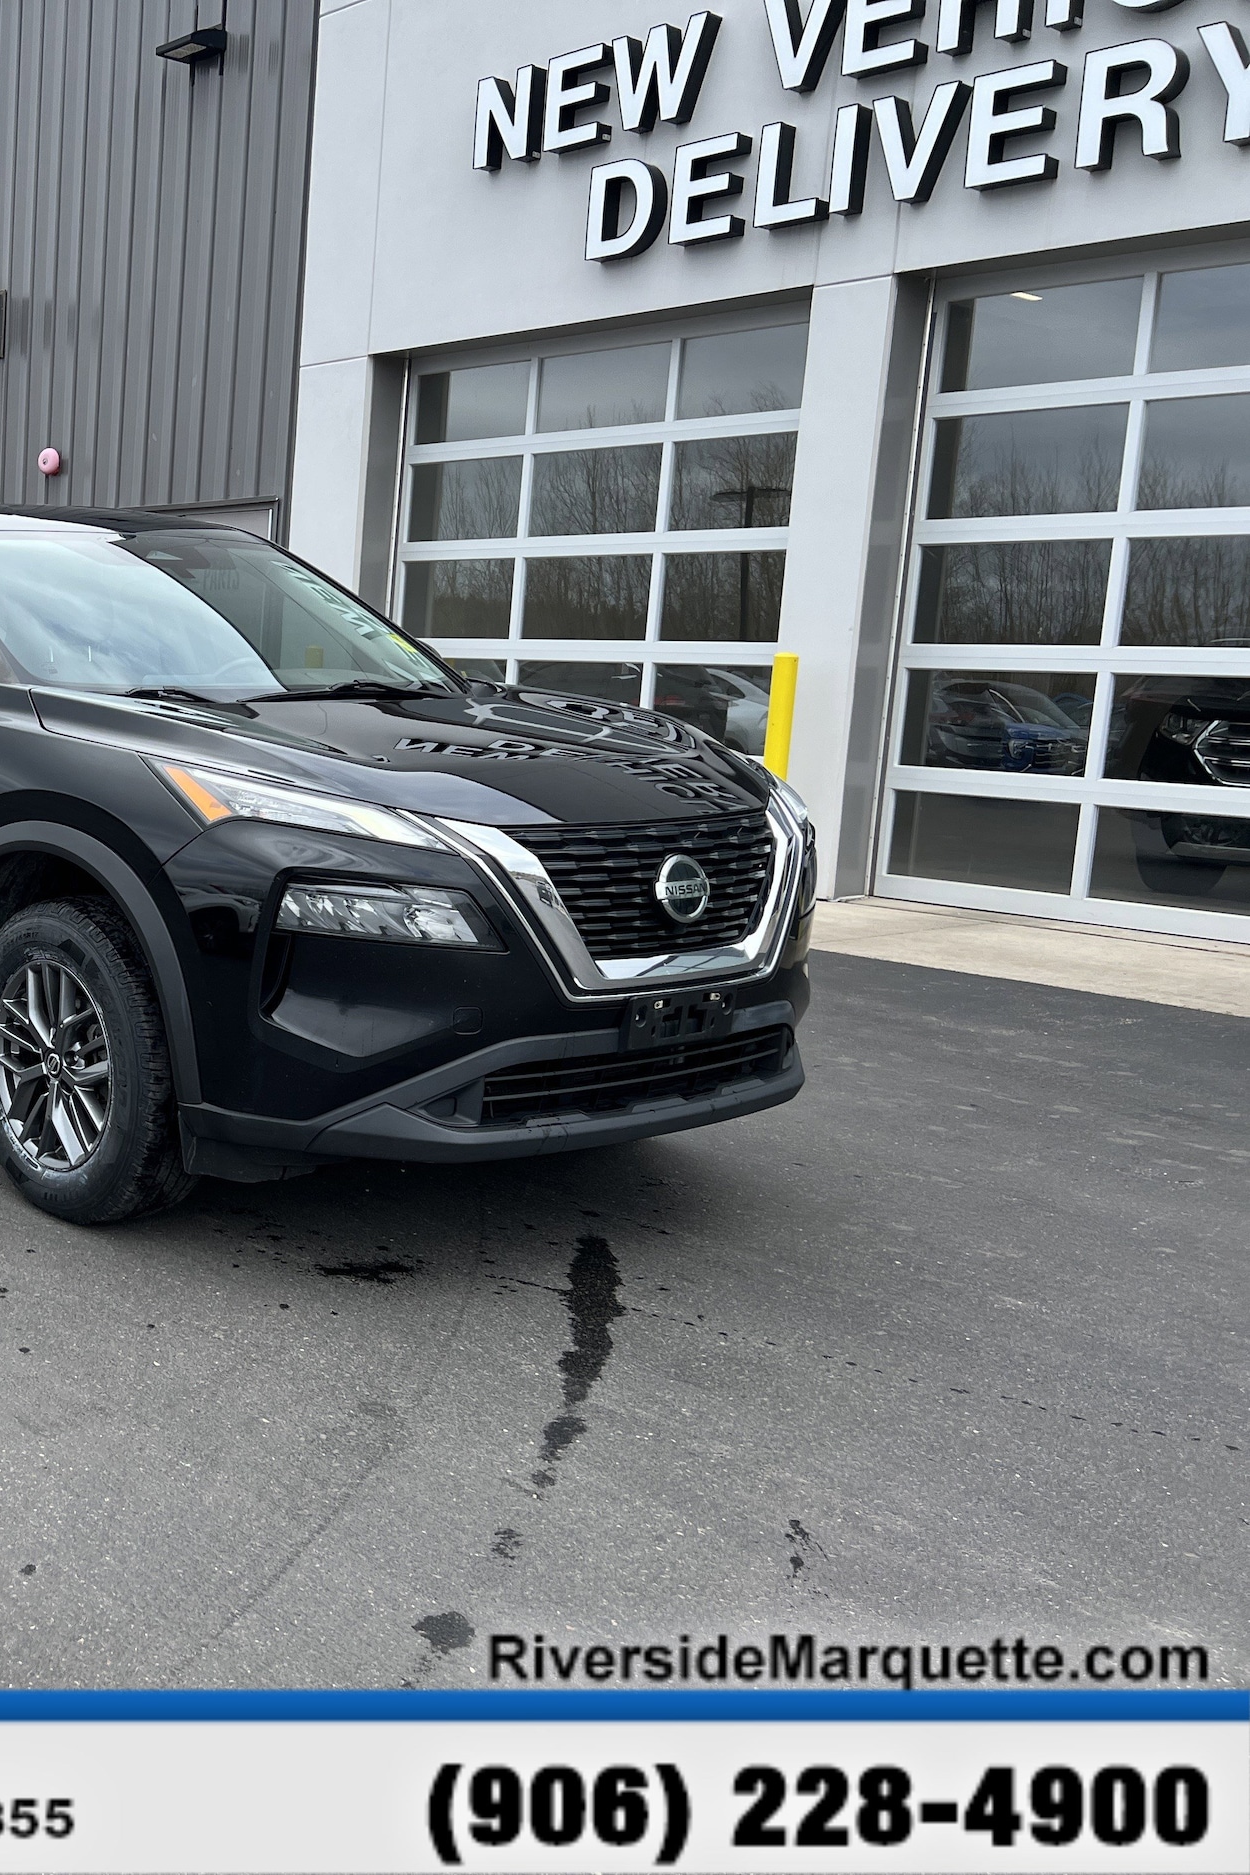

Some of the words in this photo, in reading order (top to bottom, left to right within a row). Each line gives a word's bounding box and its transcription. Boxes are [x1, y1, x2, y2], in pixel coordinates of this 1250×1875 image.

[473, 11, 722, 172] NEW
[585, 21, 1250, 262] DELIVERY
[665, 883, 706, 896] NISSAN
